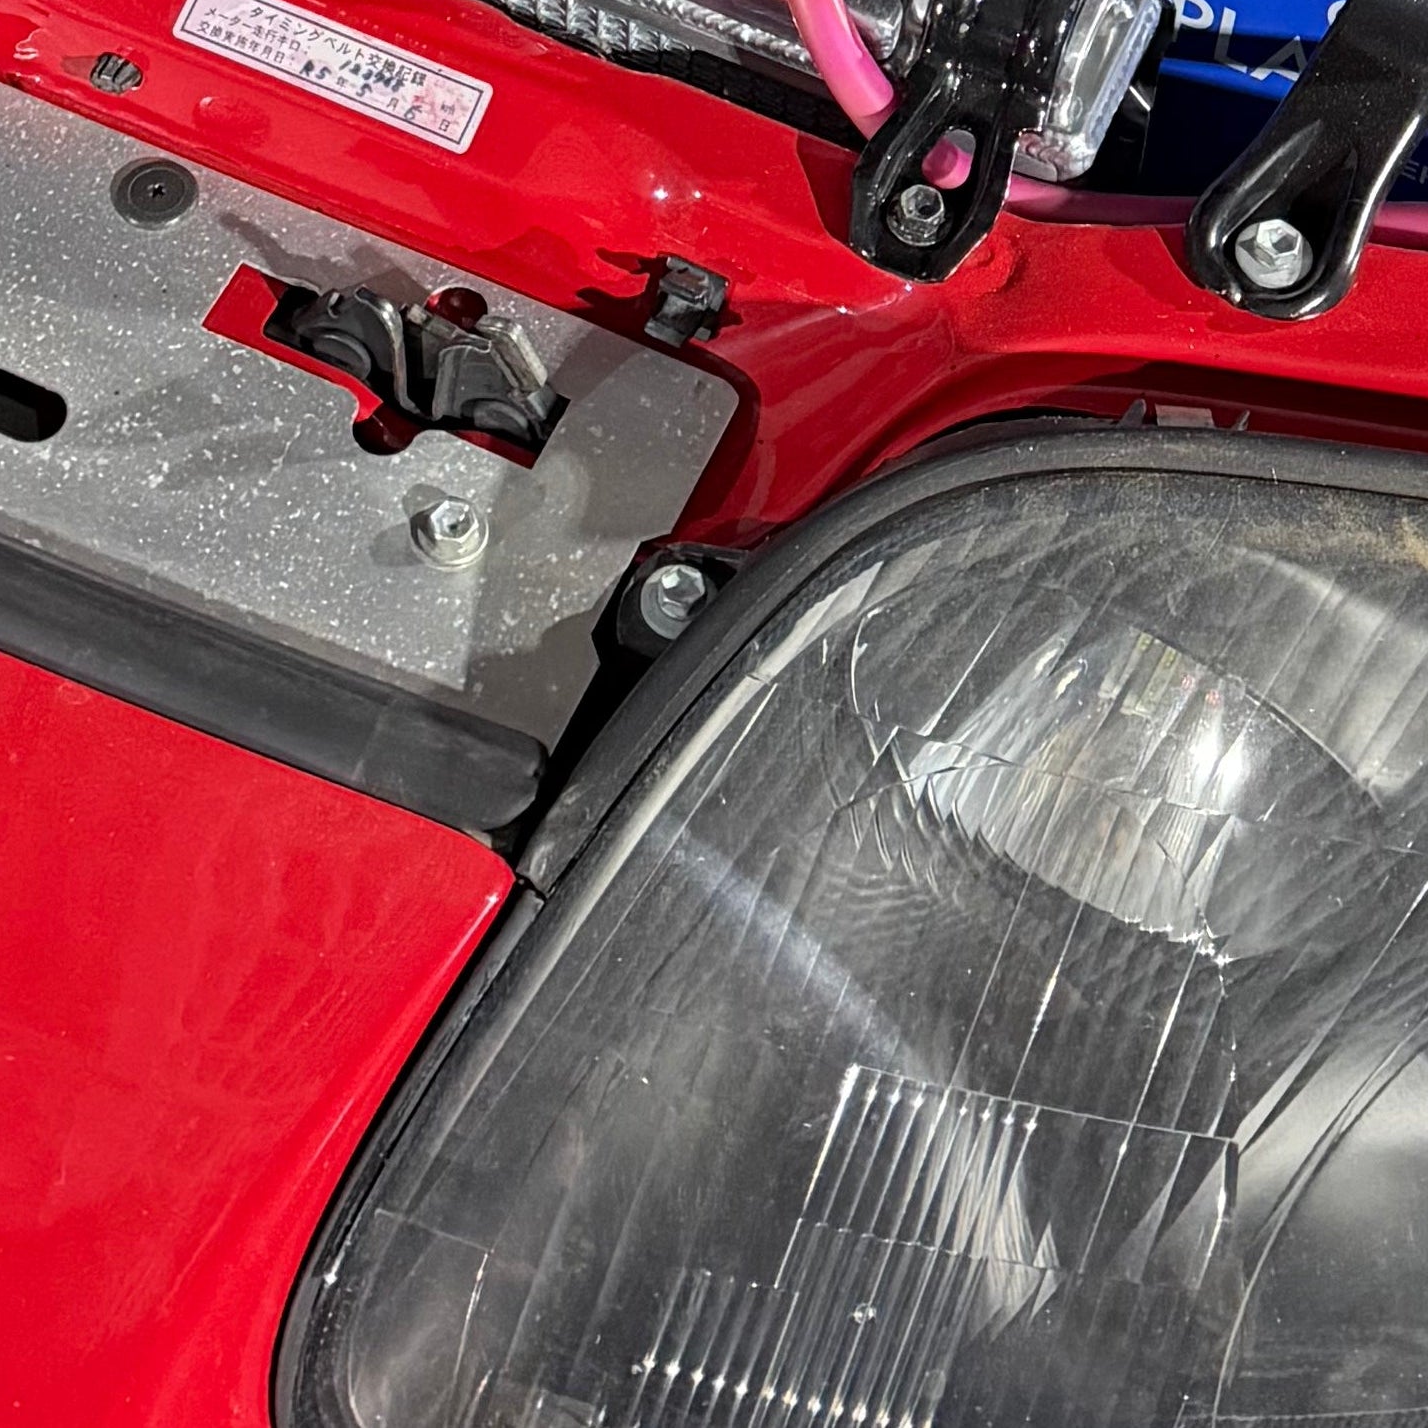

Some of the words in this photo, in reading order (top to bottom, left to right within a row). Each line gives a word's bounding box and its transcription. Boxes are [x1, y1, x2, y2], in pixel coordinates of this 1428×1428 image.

[249, 6, 428, 87] タイミングベルト交換記録
[438, 118, 452, 133] 日
